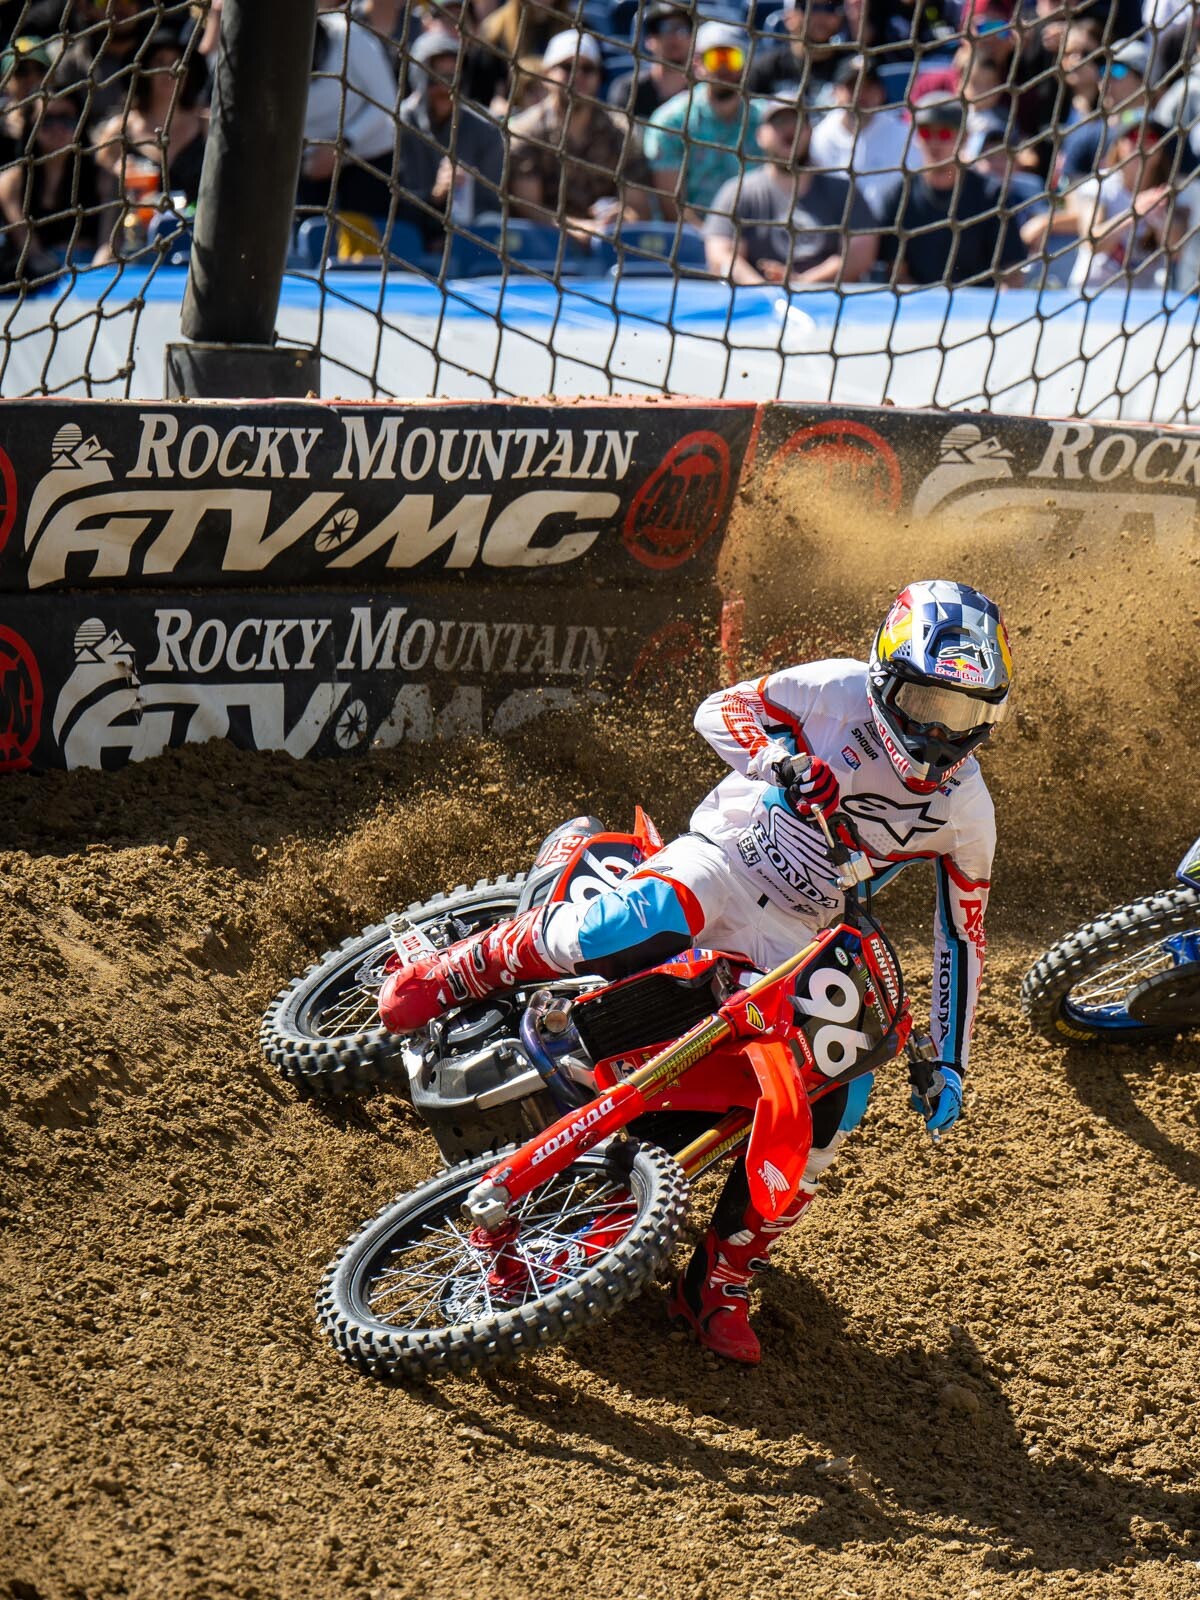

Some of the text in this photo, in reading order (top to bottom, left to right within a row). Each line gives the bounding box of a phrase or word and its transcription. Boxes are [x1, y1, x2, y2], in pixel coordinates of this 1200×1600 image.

[126, 412, 639, 483] ROCKY MOUNTAIN
[146, 606, 610, 677] ROCKY MOUNTAIN
[934, 667, 986, 685] Red Bull
[842, 747, 862, 770] 100%
[851, 727, 880, 761] SHOWA
[753, 820, 839, 909] HONDA
[870, 938, 899, 1009] RENTHAL
[939, 949, 953, 1043] HONDA
[787, 967, 873, 1078] 96
[796, 1030, 814, 1065] HONDA
[530, 1097, 616, 1167] DUNLOP
[757, 1167, 777, 1212] HONDA
